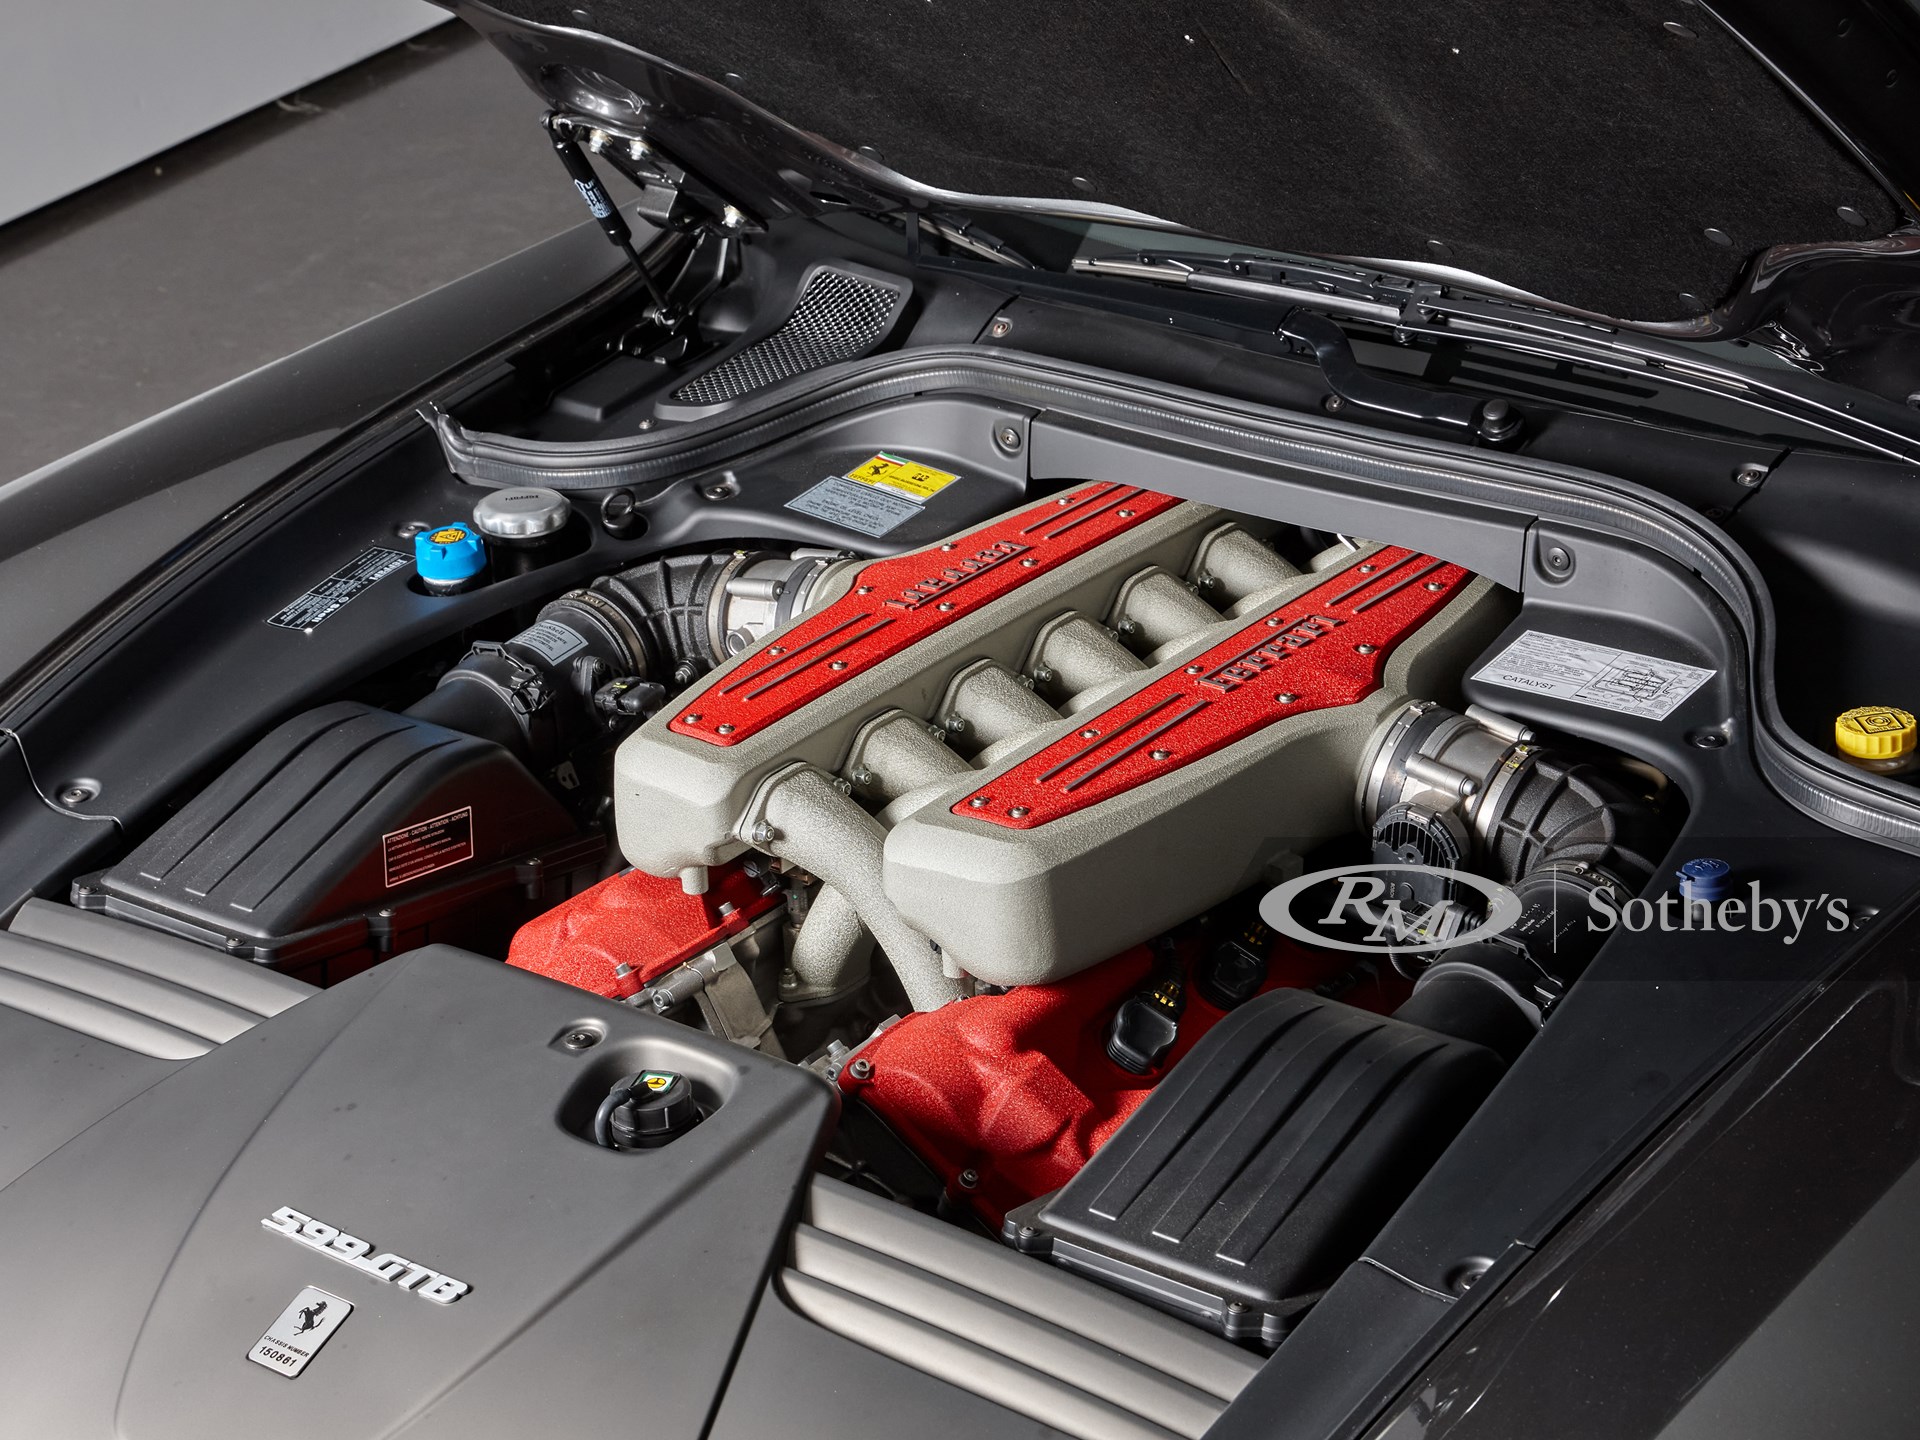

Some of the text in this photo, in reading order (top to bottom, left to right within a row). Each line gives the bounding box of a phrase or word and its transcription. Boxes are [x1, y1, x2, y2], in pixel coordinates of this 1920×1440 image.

[1195, 614, 1341, 694] Ferrari
[1503, 674, 1556, 690] CATALYST
[387, 811, 468, 843] ATTENZIONE CAUTION ATTENTION ACHTUNG
[258, 1345, 298, 1368] 150861
[264, 1335, 310, 1358] CHASSIS NUMBER
